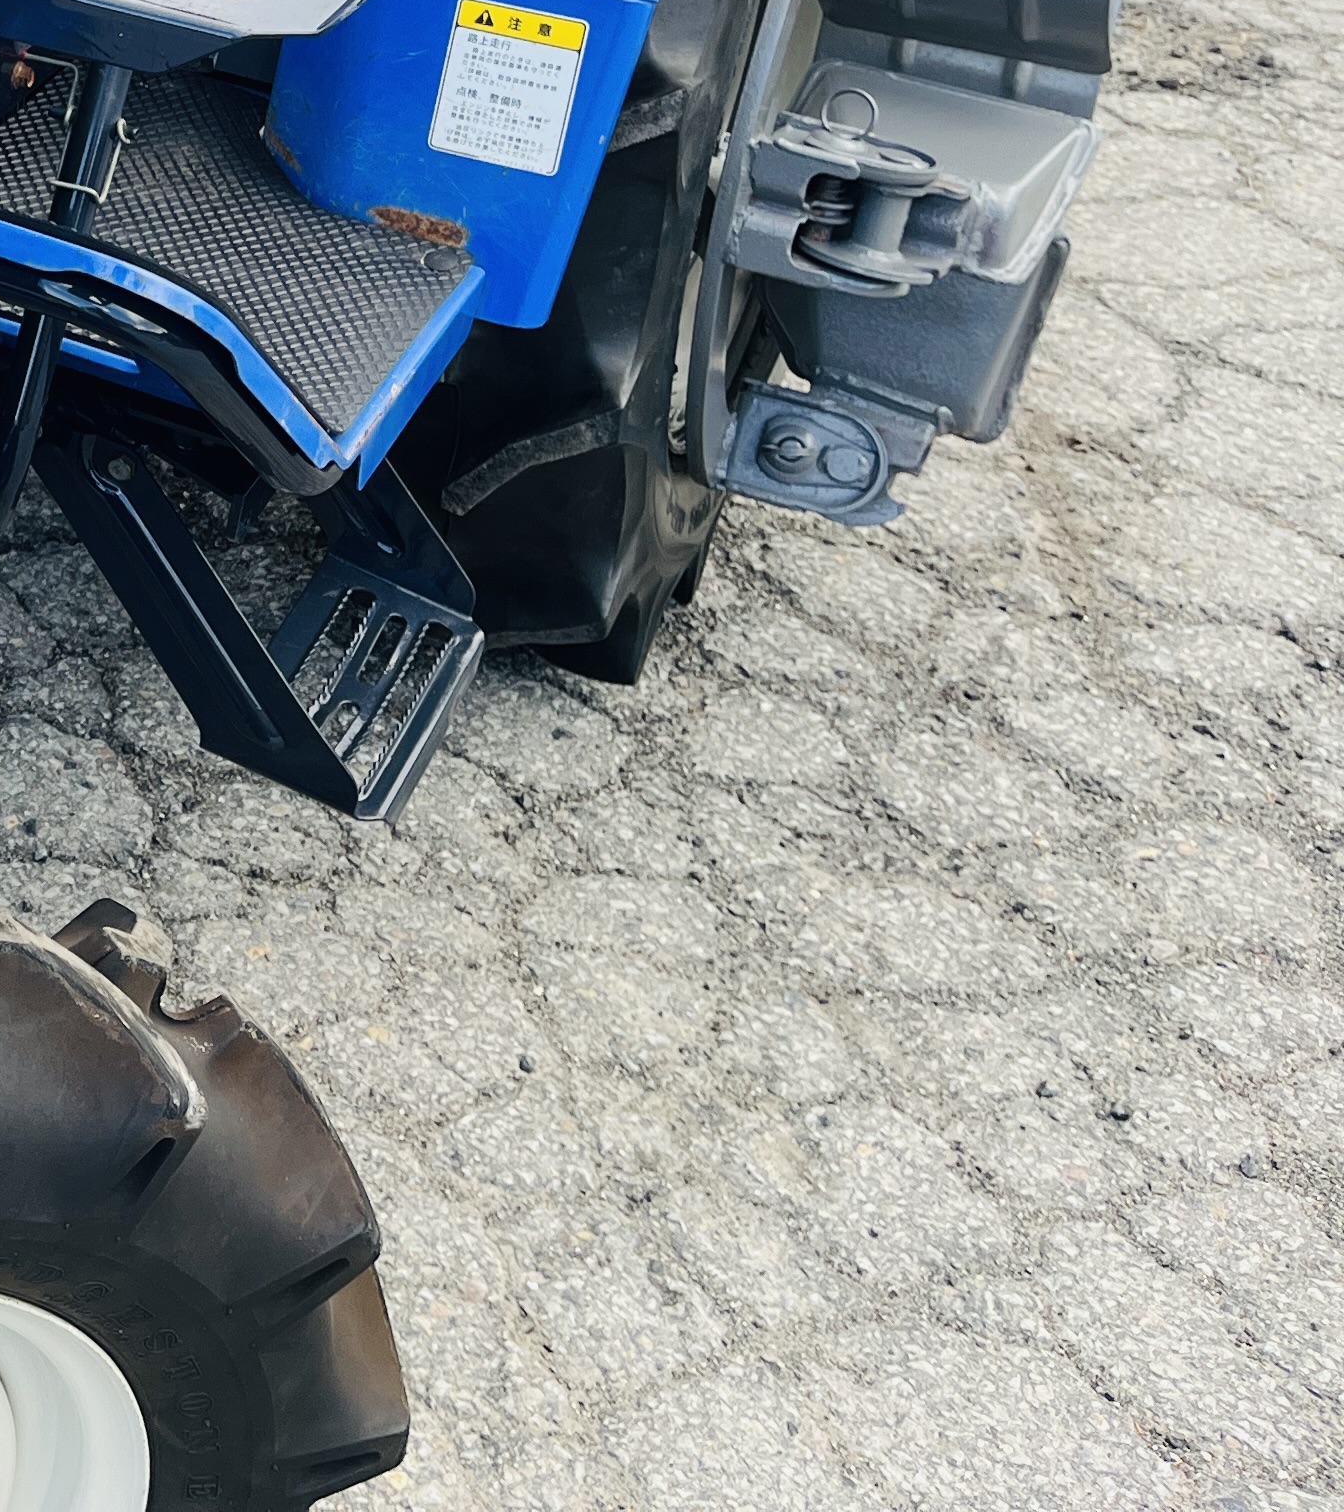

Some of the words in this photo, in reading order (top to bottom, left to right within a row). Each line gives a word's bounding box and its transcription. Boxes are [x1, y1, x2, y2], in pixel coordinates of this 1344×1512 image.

[507, 16, 552, 37] 注意
[467, 32, 511, 50] 路上走行
